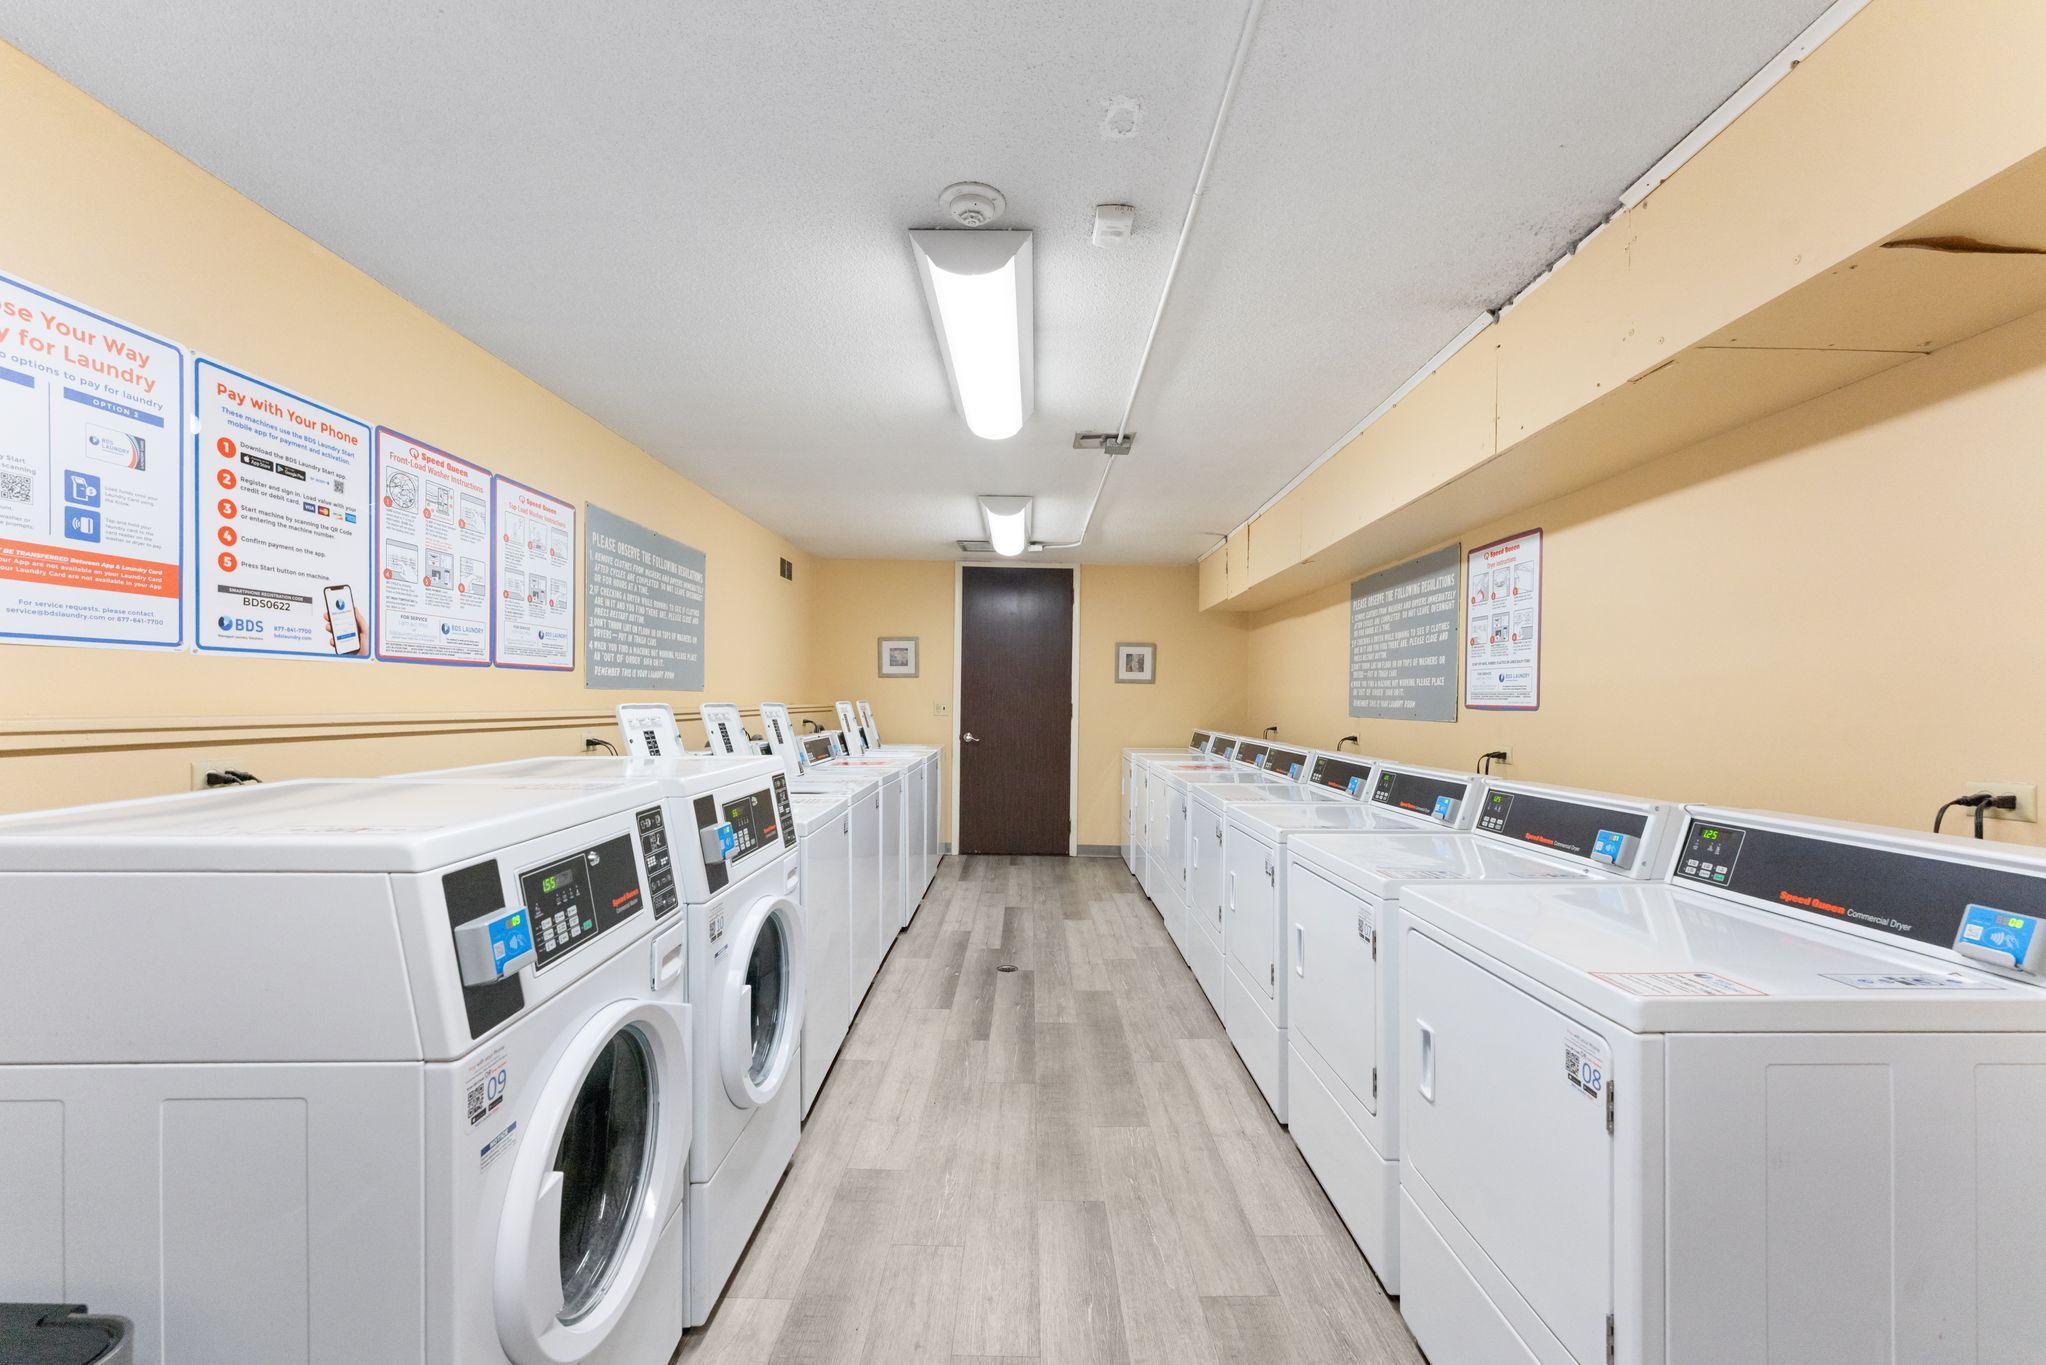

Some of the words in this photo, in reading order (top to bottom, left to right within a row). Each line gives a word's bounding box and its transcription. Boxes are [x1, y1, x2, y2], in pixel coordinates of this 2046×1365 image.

[0, 301, 33, 322] se
[41, 311, 97, 346] Your
[102, 334, 150, 369] Way
[18, 328, 56, 356] for
[64, 345, 156, 393] Laundry
[11, 355, 60, 377] options
[63, 371, 76, 382] to
[80, 377, 101, 391] pay
[104, 384, 119, 396] for
[123, 390, 164, 411] laundry
[92, 399, 130, 416] OPTION
[217, 383, 246, 407] Pay
[250, 397, 283, 418] with
[287, 408, 317, 430] Your
[321, 422, 358, 446] Phone
[222, 407, 243, 419] These
[245, 415, 278, 432] machines
[280, 427, 290, 435] use
[292, 428, 302, 439] the
[304, 435, 316, 445] BDS
[318, 440, 340, 454] Laundry
[341, 449, 355, 458] Start
[227, 419, 252, 432] mobile
[254, 428, 267, 438] app
[269, 432, 278, 440] for
[280, 437, 308, 452] payment
[309, 446, 320, 455] and
[321, 451, 350, 465] activation.
[223, 442, 230, 452] 1
[2, 463, 36, 475] scanning
[6, 455, 25, 464] Start
[240, 441, 273, 457] Download
[274, 451, 284, 460] the
[285, 454, 297, 464] BDS
[298, 459, 321, 473] Laundry
[322, 467, 335, 476] Start
[336, 472, 347, 480] app.
[421, 452, 445, 468] Speed
[447, 463, 468, 477] Queen
[222, 473, 231, 485] 2
[389, 451, 426, 472] Front-Load
[428, 467, 450, 480] Washer
[451, 475, 484, 493] Instructions
[240, 476, 267, 489] Register
[269, 483, 280, 492] and
[281, 487, 294, 496] sign
[303, 494, 316, 502] Load
[318, 497, 332, 506] value
[333, 500, 344, 509] with
[240, 486, 259, 495] credit
[269, 491, 285, 501] debit
[286, 496, 300, 505] card.
[223, 503, 232, 514] 3
[526, 498, 541, 509] Speed
[241, 504, 257, 513] Start
[258, 508, 284, 520] machine
[286, 514, 293, 523] by
[294, 517, 320, 529] scanning
[321, 522, 329, 531] the
[339, 528, 352, 536] Code
[250, 515, 276, 527] entering
[277, 522, 288, 530] the
[289, 524, 312, 535] machine
[314, 529, 335, 539] number.
[223, 530, 232, 542] 4
[241, 536, 267, 546] Confirm
[268, 541, 294, 552] payment
[304, 547, 314, 555] the
[592, 531, 616, 553] PLEASE
[617, 541, 640, 561] OBSERVE
[641, 550, 650, 565] THE
[652, 554, 677, 574] FOLLOWING
[1490, 548, 1504, 558] Speed
[1505, 544, 1521, 553] Queen
[14, 558, 30, 566] App
[60, 565, 92, 573] available
[121, 573, 146, 581] Laundry
[16, 550, 69, 562] TRANSFERRED
[70, 557, 100, 567] Between
[121, 565, 147, 574] Laundry
[224, 556, 232, 568] 5
[241, 561, 258, 569] Press
[260, 564, 275, 573] Start
[276, 566, 297, 576] button
[306, 571, 330, 581] machine.
[594, 562, 608, 574] AFTER
[609, 566, 625, 579] CYCLES
[1487, 562, 1496, 570] Dryer
[16, 566, 47, 577] Laundry
[95, 577, 125, 585] available
[229, 587, 261, 596] SMARTPHONE
[261, 591, 291, 601] REGISTRATION
[1352, 597, 1367, 611] PLEASE
[1367, 592, 1384, 607] OBSERVE
[1385, 589, 1394, 603] THE
[1394, 582, 1420, 600] FOLLOWING
[1421, 572, 1454, 593] REGULATIONS
[6, 607, 106, 621] service@bdslaundry.com
[35, 601, 64, 609] service
[65, 605, 101, 614] requests,
[102, 606, 126, 615] please
[128, 609, 154, 617] contact
[243, 597, 291, 612] BDS0622
[1416, 605, 1429, 616] LEAVE
[235, 618, 264, 633] BDS
[1430, 621, 1449, 632] CLOTHES
[1415, 677, 1430, 686] PLEASE
[1431, 676, 1445, 685] PLACE
[1525, 832, 1539, 842] Speed
[1554, 840, 1571, 849] Commercial
[1780, 891, 1811, 906] Speed
[1812, 899, 1846, 914] Queen
[1847, 908, 1889, 926] Commercial
[1890, 919, 1912, 932] Dryer
[487, 1068, 507, 1101] 09
[1582, 1062, 1601, 1091] 08
